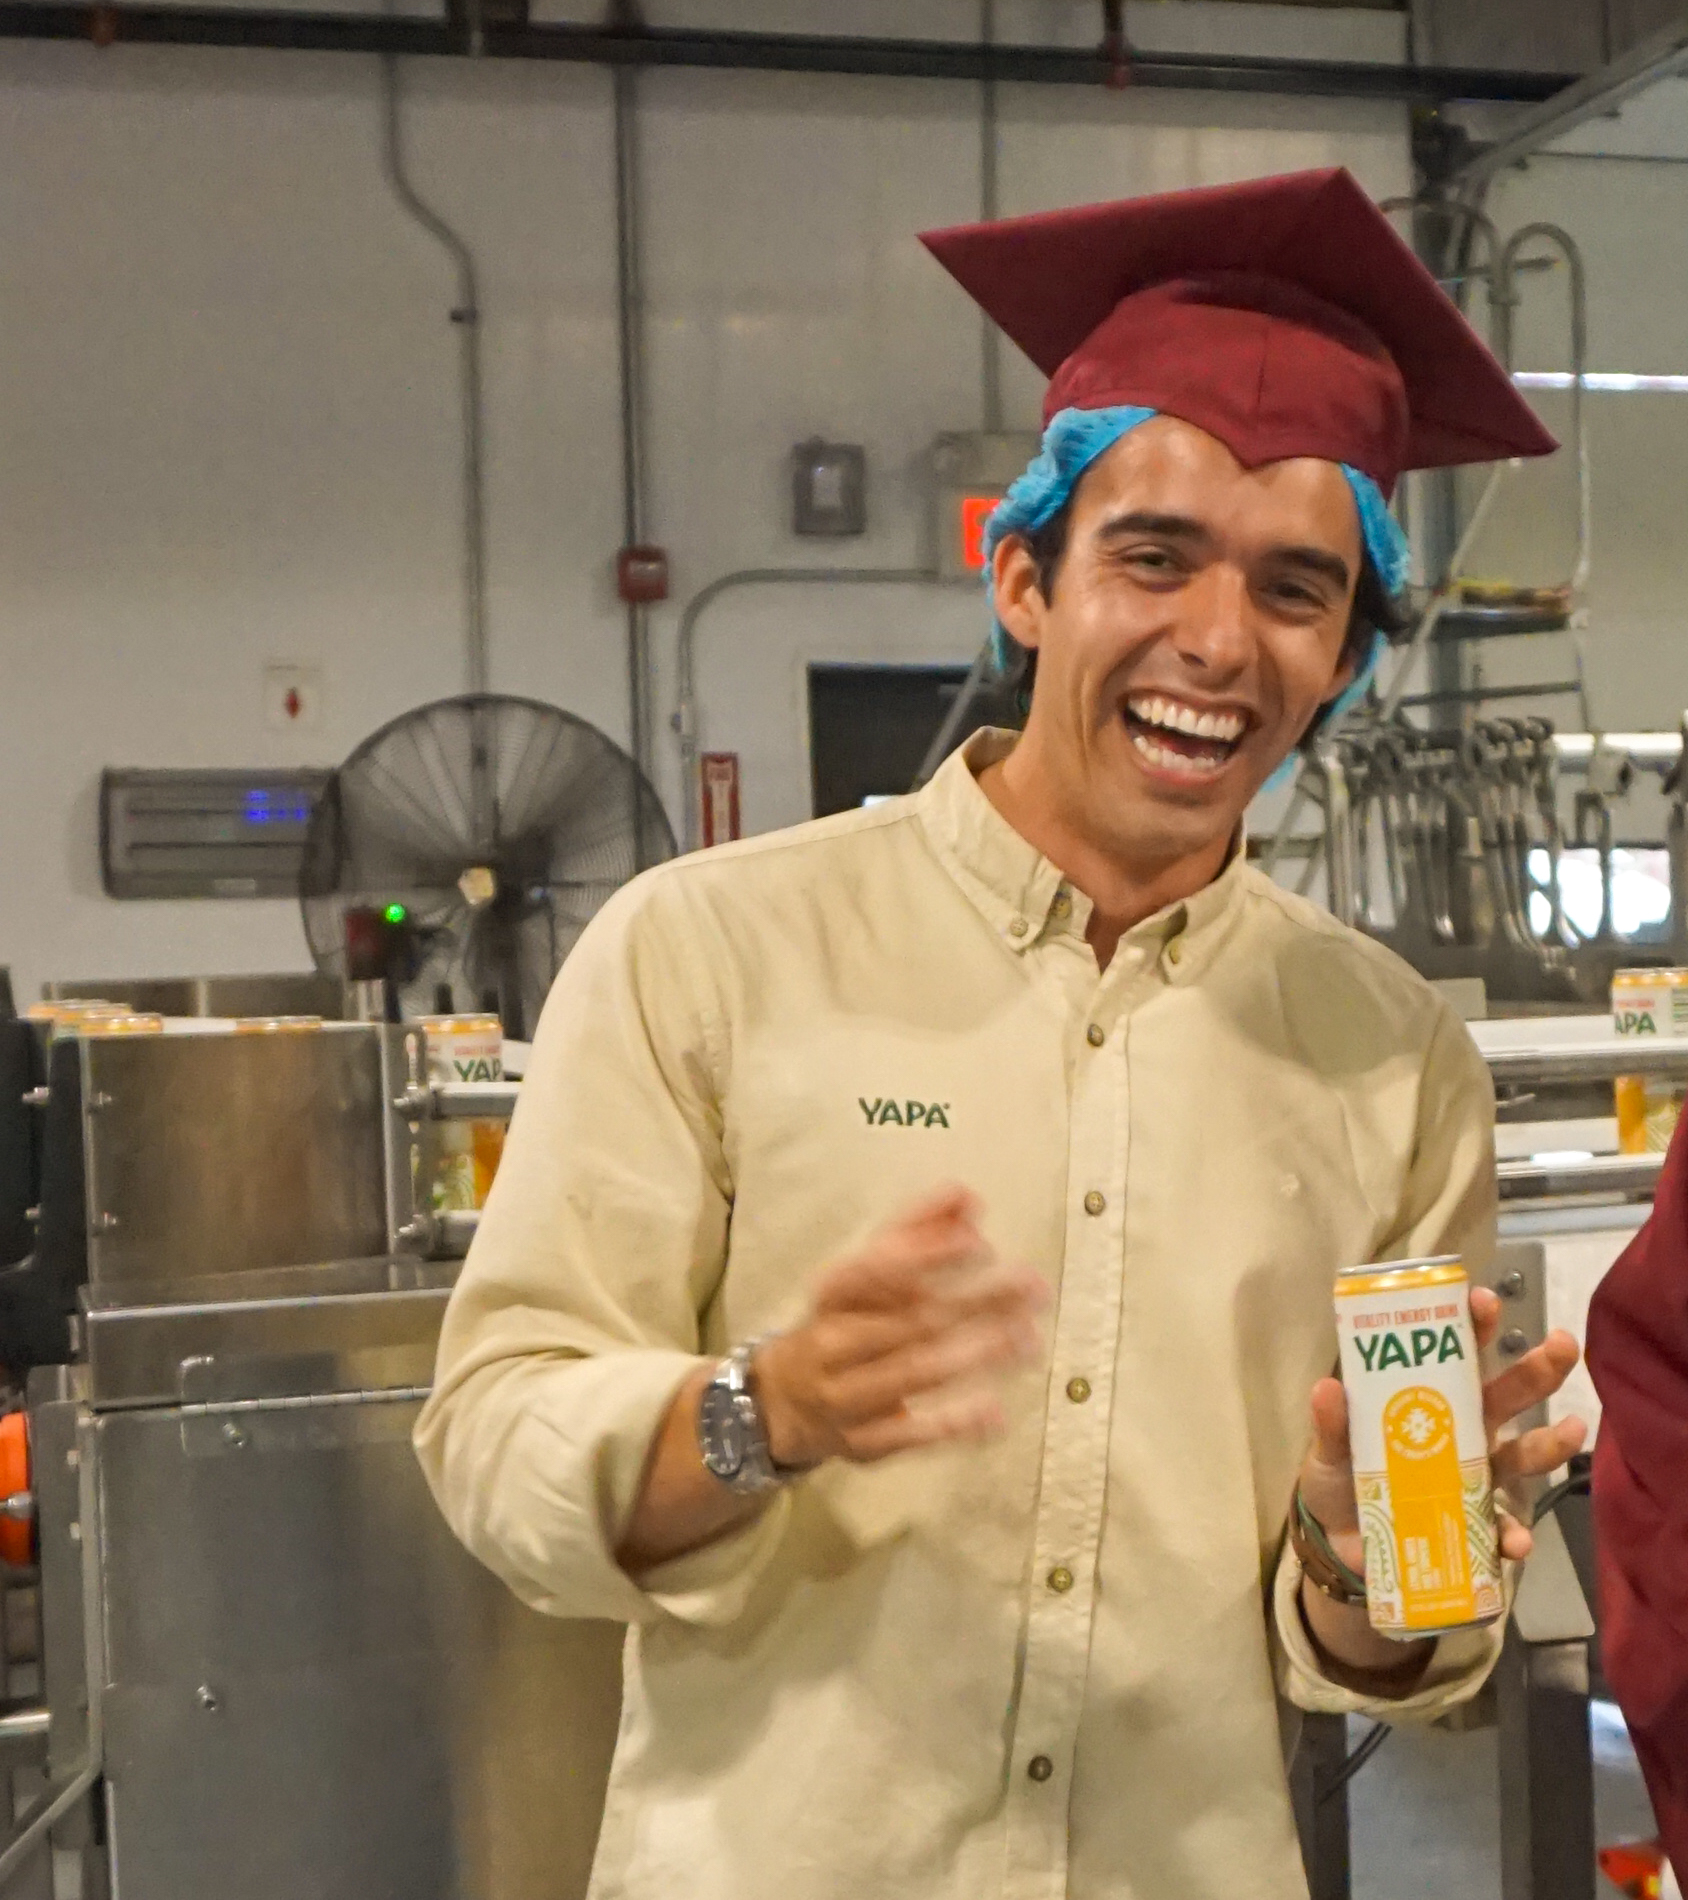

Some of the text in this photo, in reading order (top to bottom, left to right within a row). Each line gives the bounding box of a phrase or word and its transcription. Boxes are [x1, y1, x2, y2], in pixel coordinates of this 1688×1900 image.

[1614, 1011, 1656, 1034] APA
[453, 1058, 502, 1082] YAP
[858, 1097, 950, 1128] YAPA
[1395, 1308, 1431, 1325] ENERGY
[1354, 1324, 1464, 1372] YAPA
